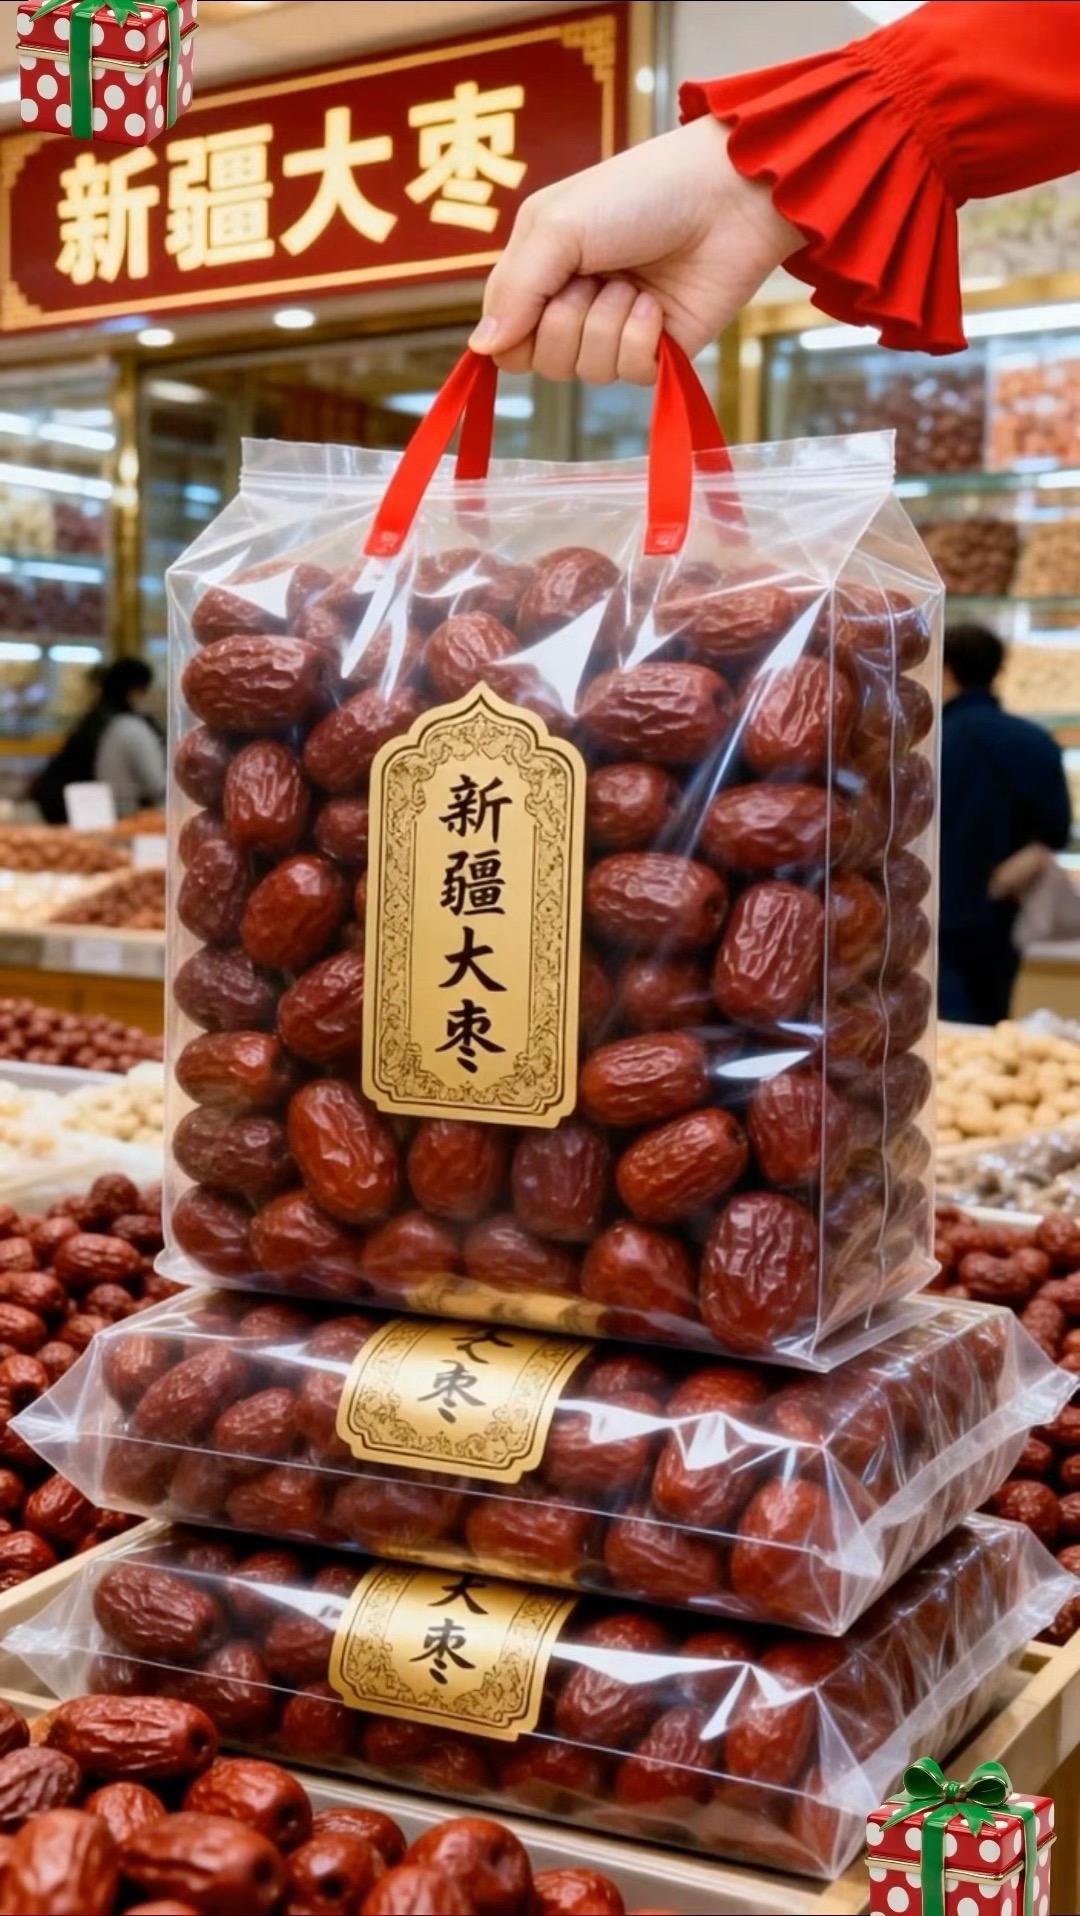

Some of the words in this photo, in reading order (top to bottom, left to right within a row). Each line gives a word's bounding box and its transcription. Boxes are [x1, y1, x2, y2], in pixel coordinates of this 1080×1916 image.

[55, 81, 527, 286] 新疆大枣
[435, 774, 513, 1074] 新疆大枣
